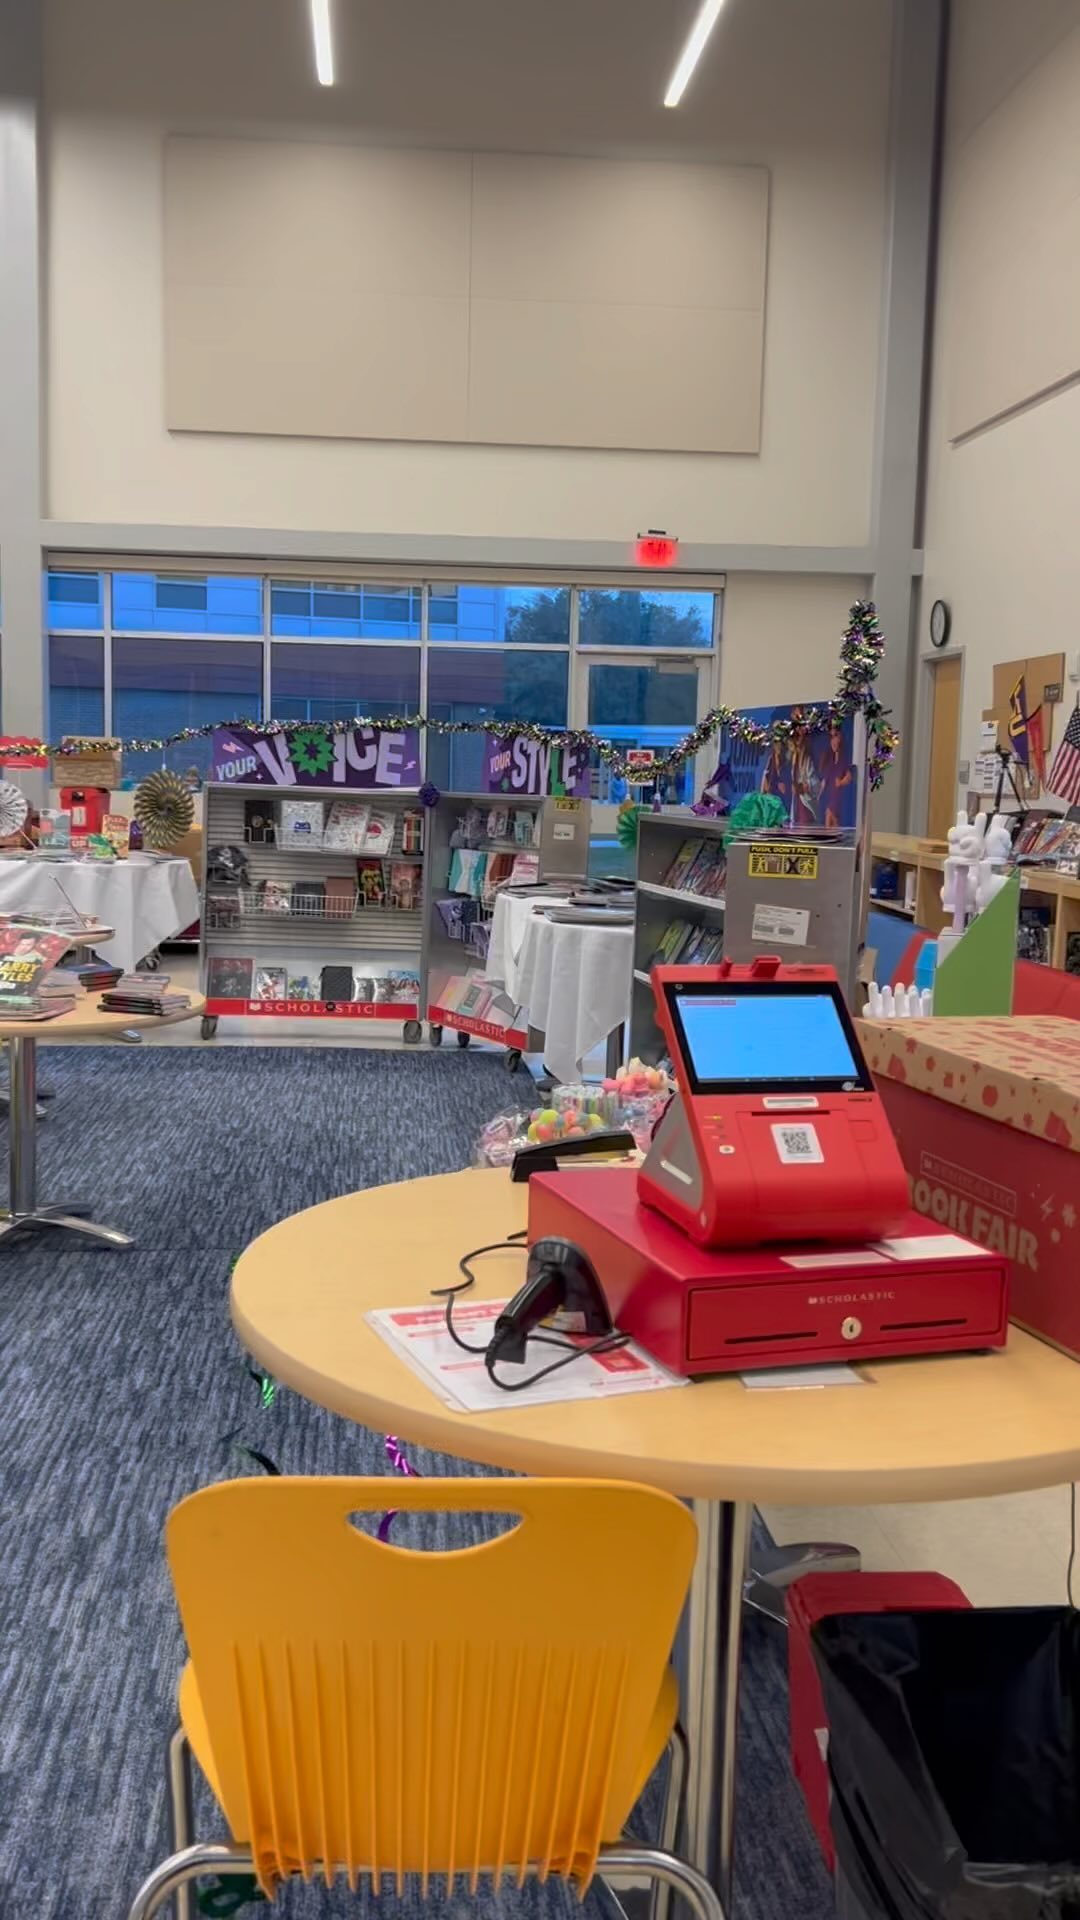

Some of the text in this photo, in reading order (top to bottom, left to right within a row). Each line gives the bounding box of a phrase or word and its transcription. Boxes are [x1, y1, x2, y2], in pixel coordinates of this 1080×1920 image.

[216, 729, 406, 785] YOUR VOICE
[511, 736, 577, 796] STYLE
[0, 961, 39, 973] ARRY
[264, 1002, 373, 1015] SCHOLSTIC
[971, 1206, 1039, 1273] FAIR
[818, 1291, 896, 1305] SCHOLASTIC
